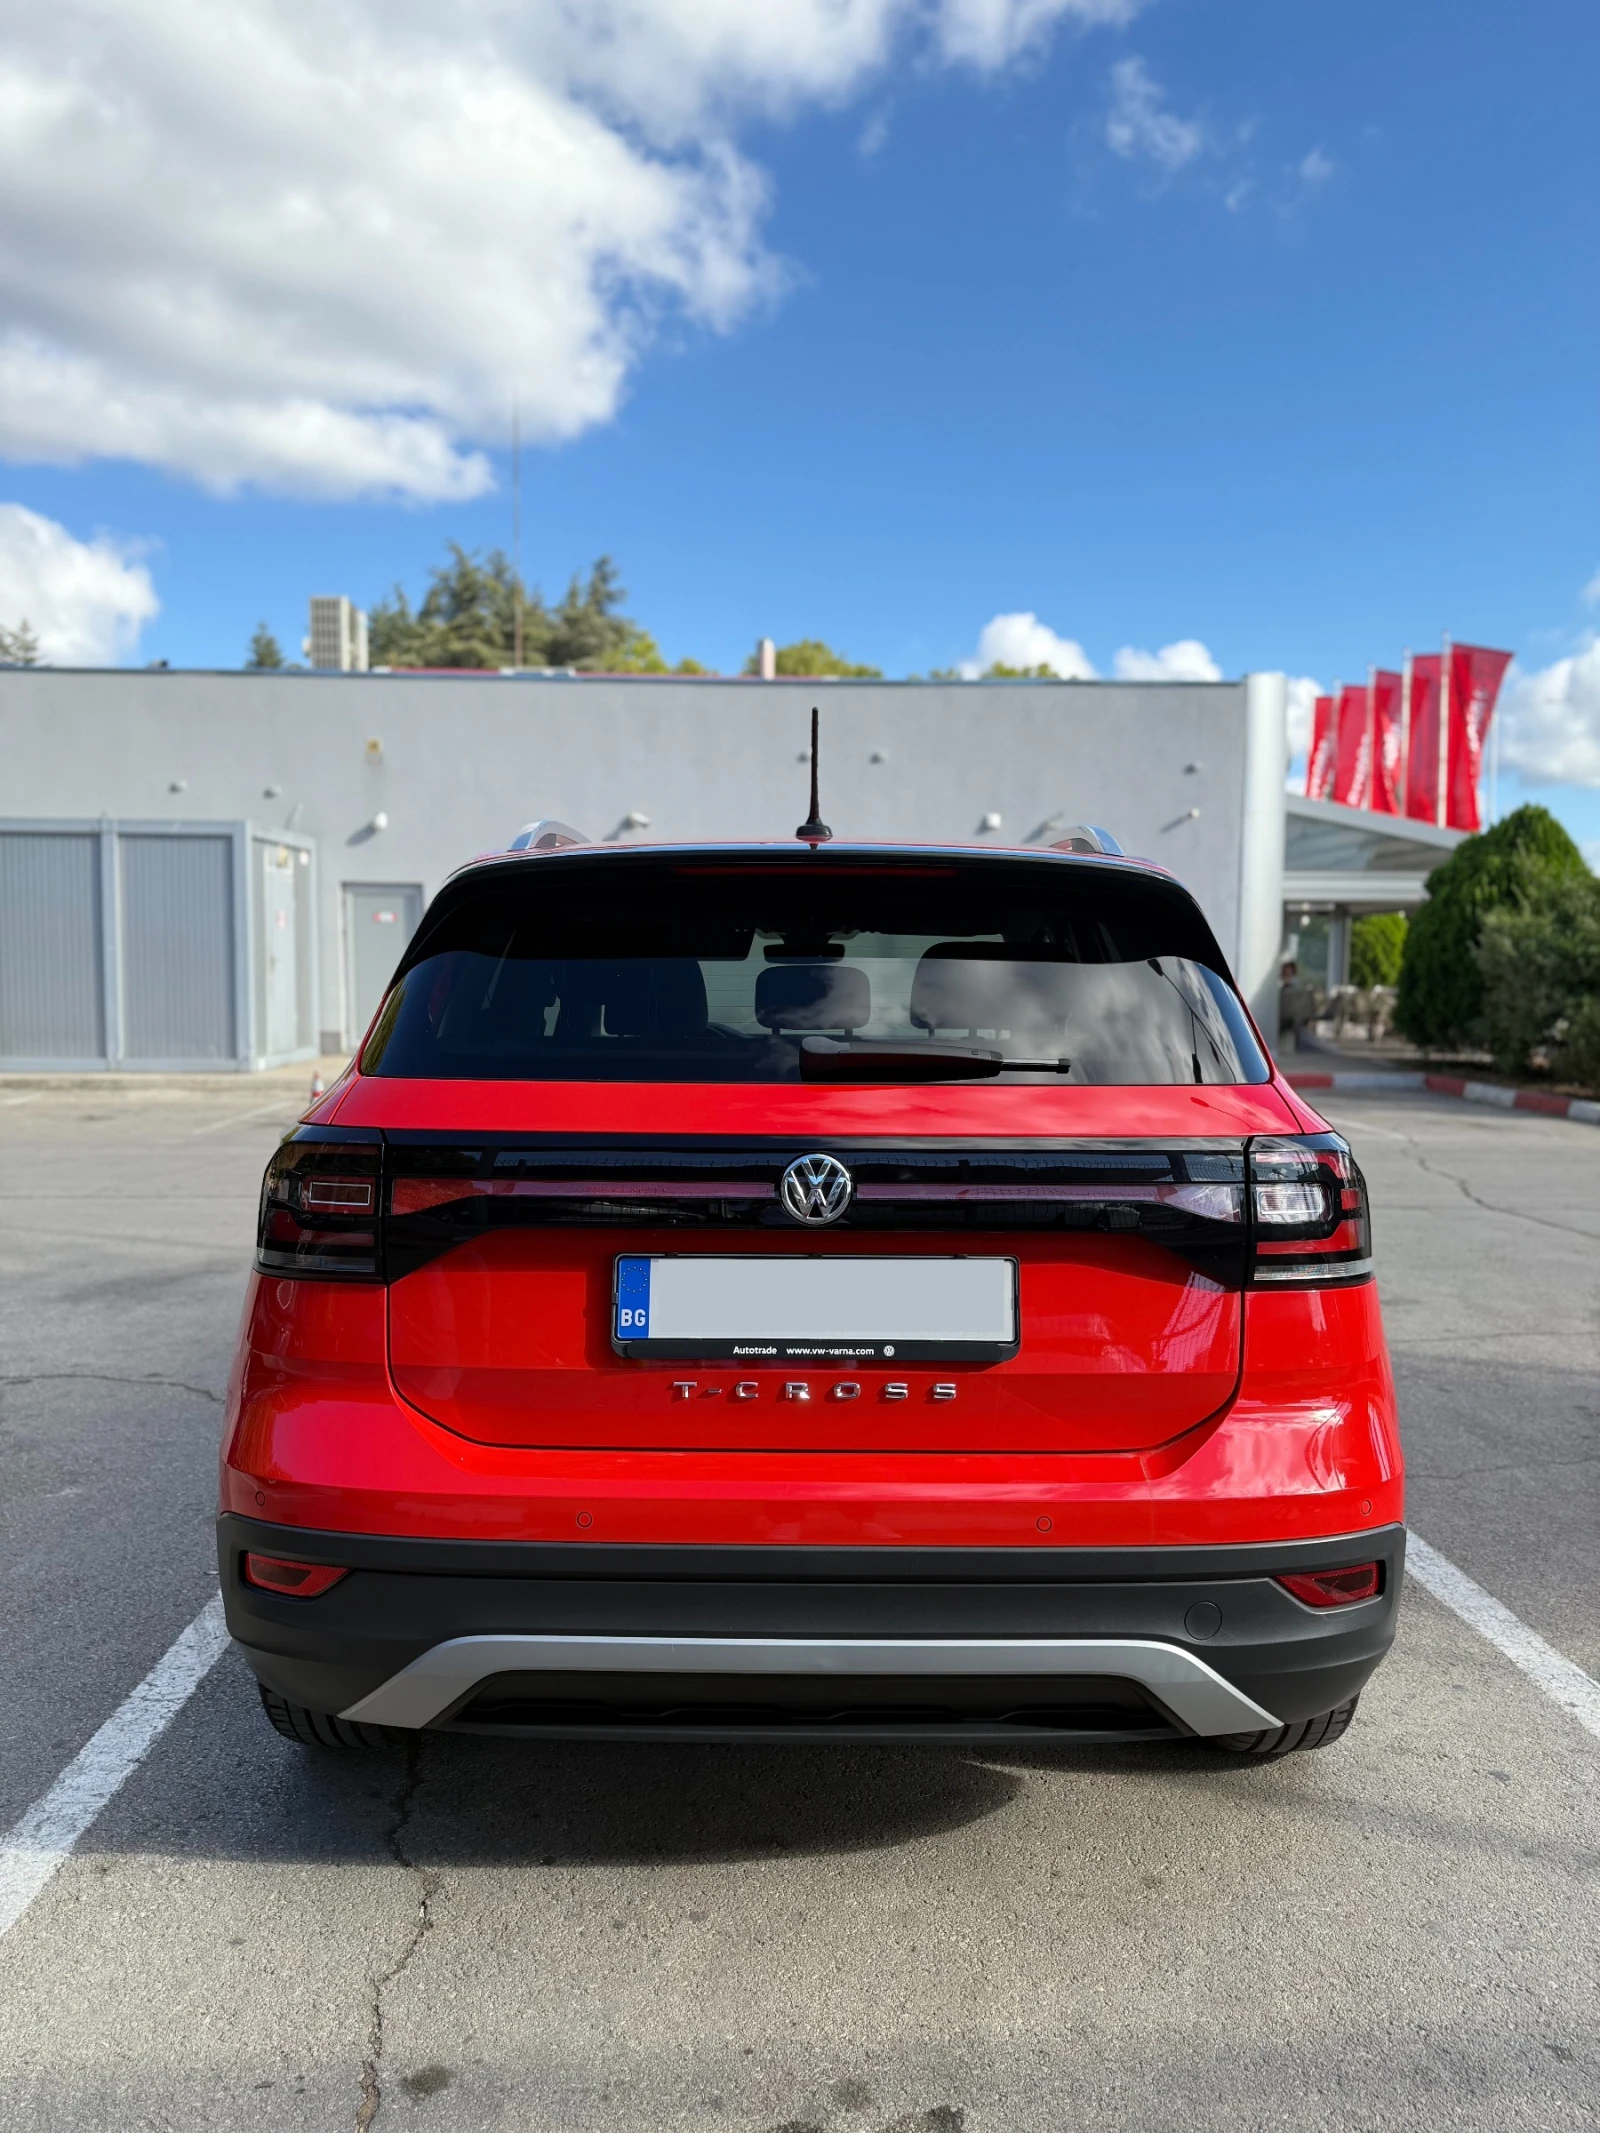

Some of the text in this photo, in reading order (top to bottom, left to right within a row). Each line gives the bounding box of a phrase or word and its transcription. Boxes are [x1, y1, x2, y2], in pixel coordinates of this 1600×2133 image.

[620, 1308, 646, 1327] BG
[733, 1345, 778, 1355] Autotrade
[786, 1346, 875, 1356] www.vw-varna.com
[673, 1381, 957, 1400] T-CROSS
